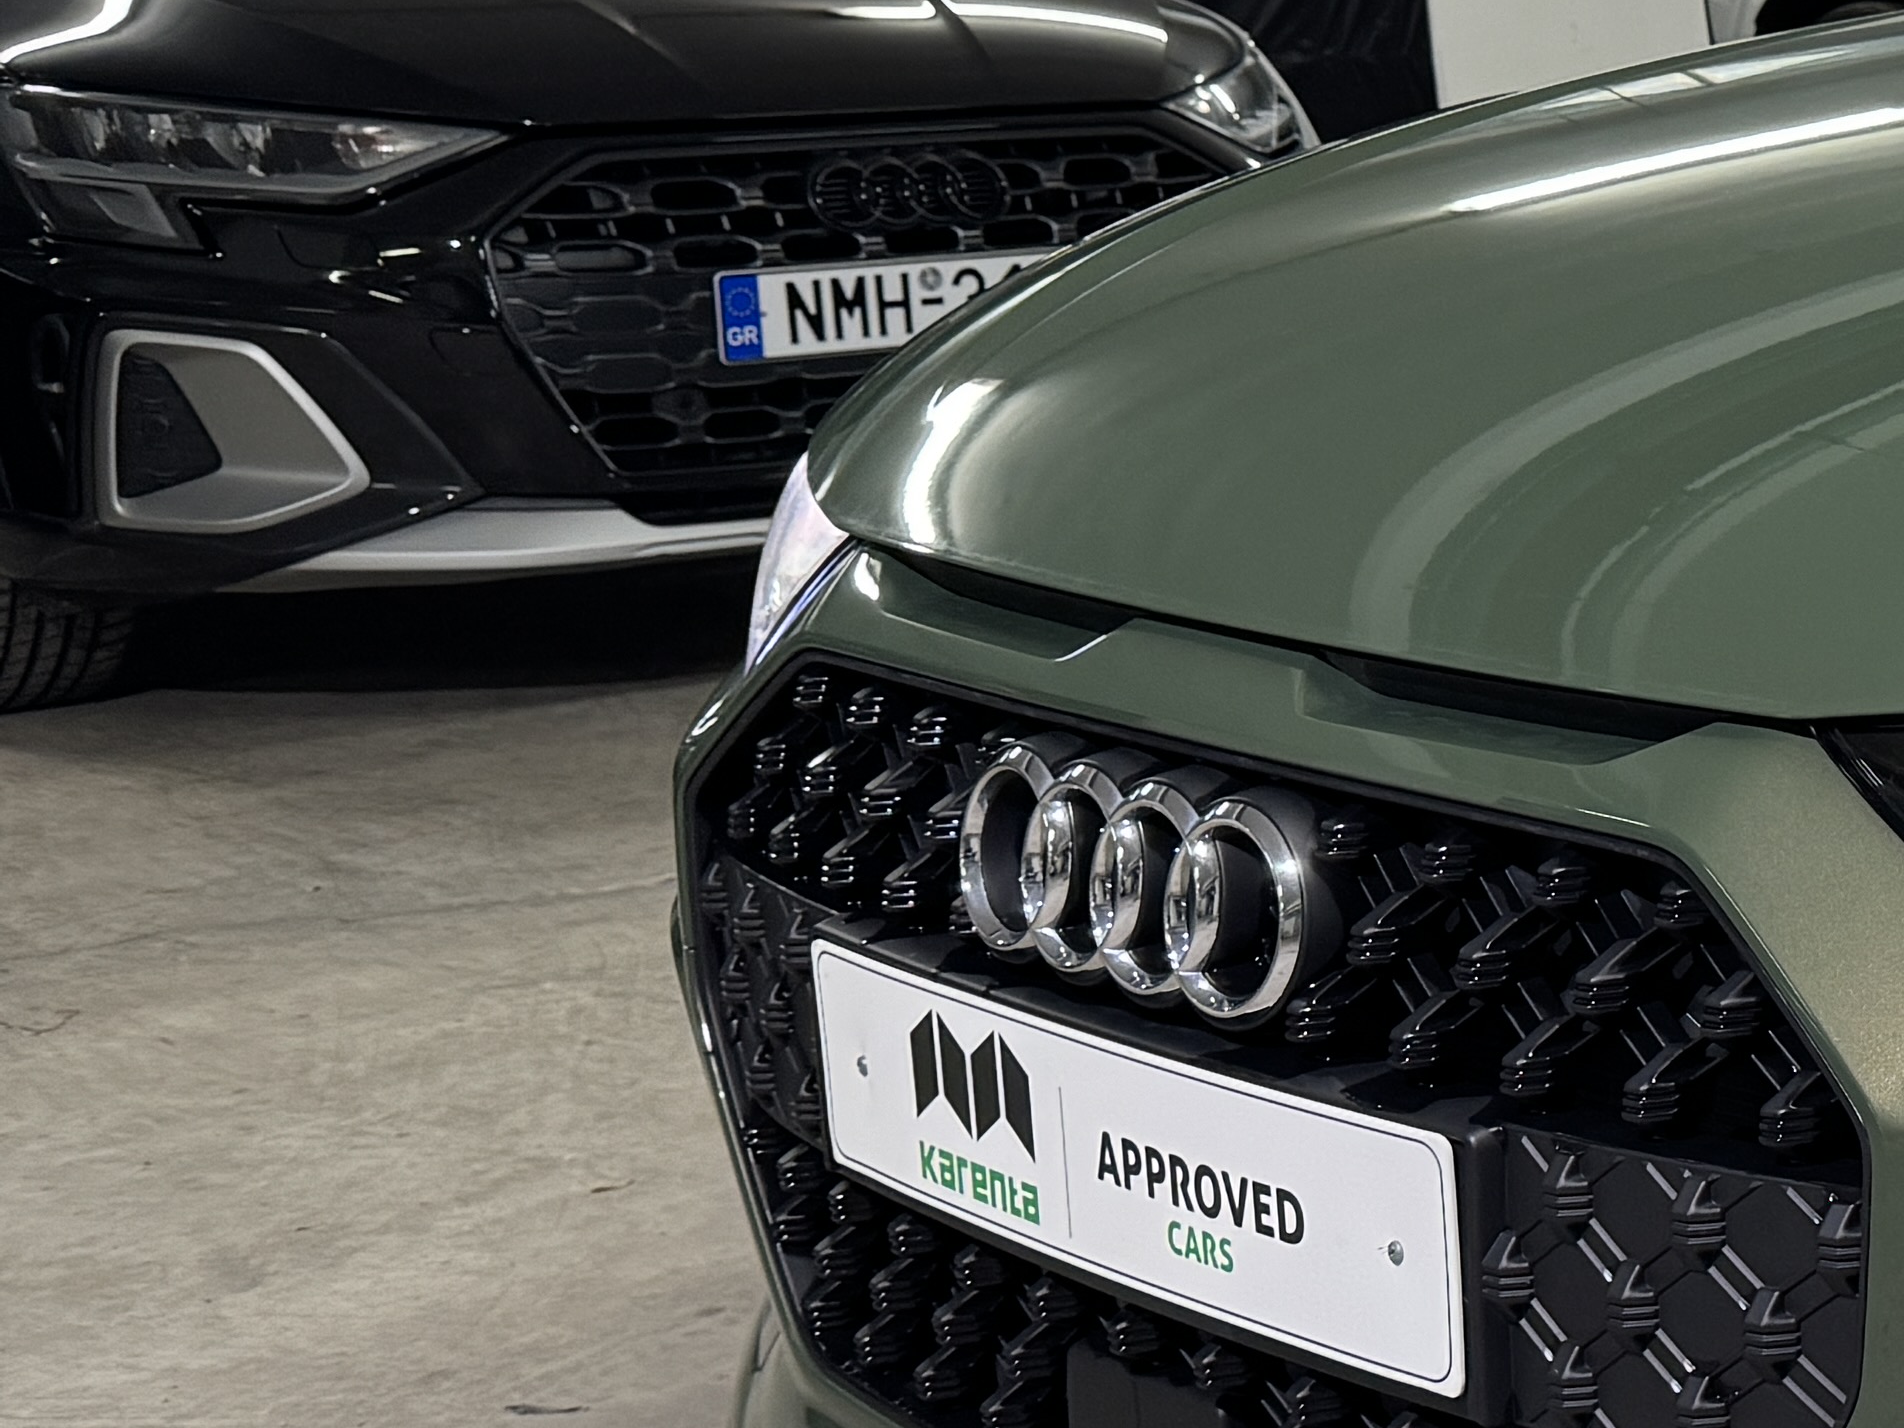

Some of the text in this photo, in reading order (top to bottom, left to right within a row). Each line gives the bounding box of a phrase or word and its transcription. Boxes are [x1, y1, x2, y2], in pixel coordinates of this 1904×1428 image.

[726, 326, 759, 347] GR
[1097, 1131, 1305, 1245] APPROVED
[1168, 1221, 1234, 1273] CARS
